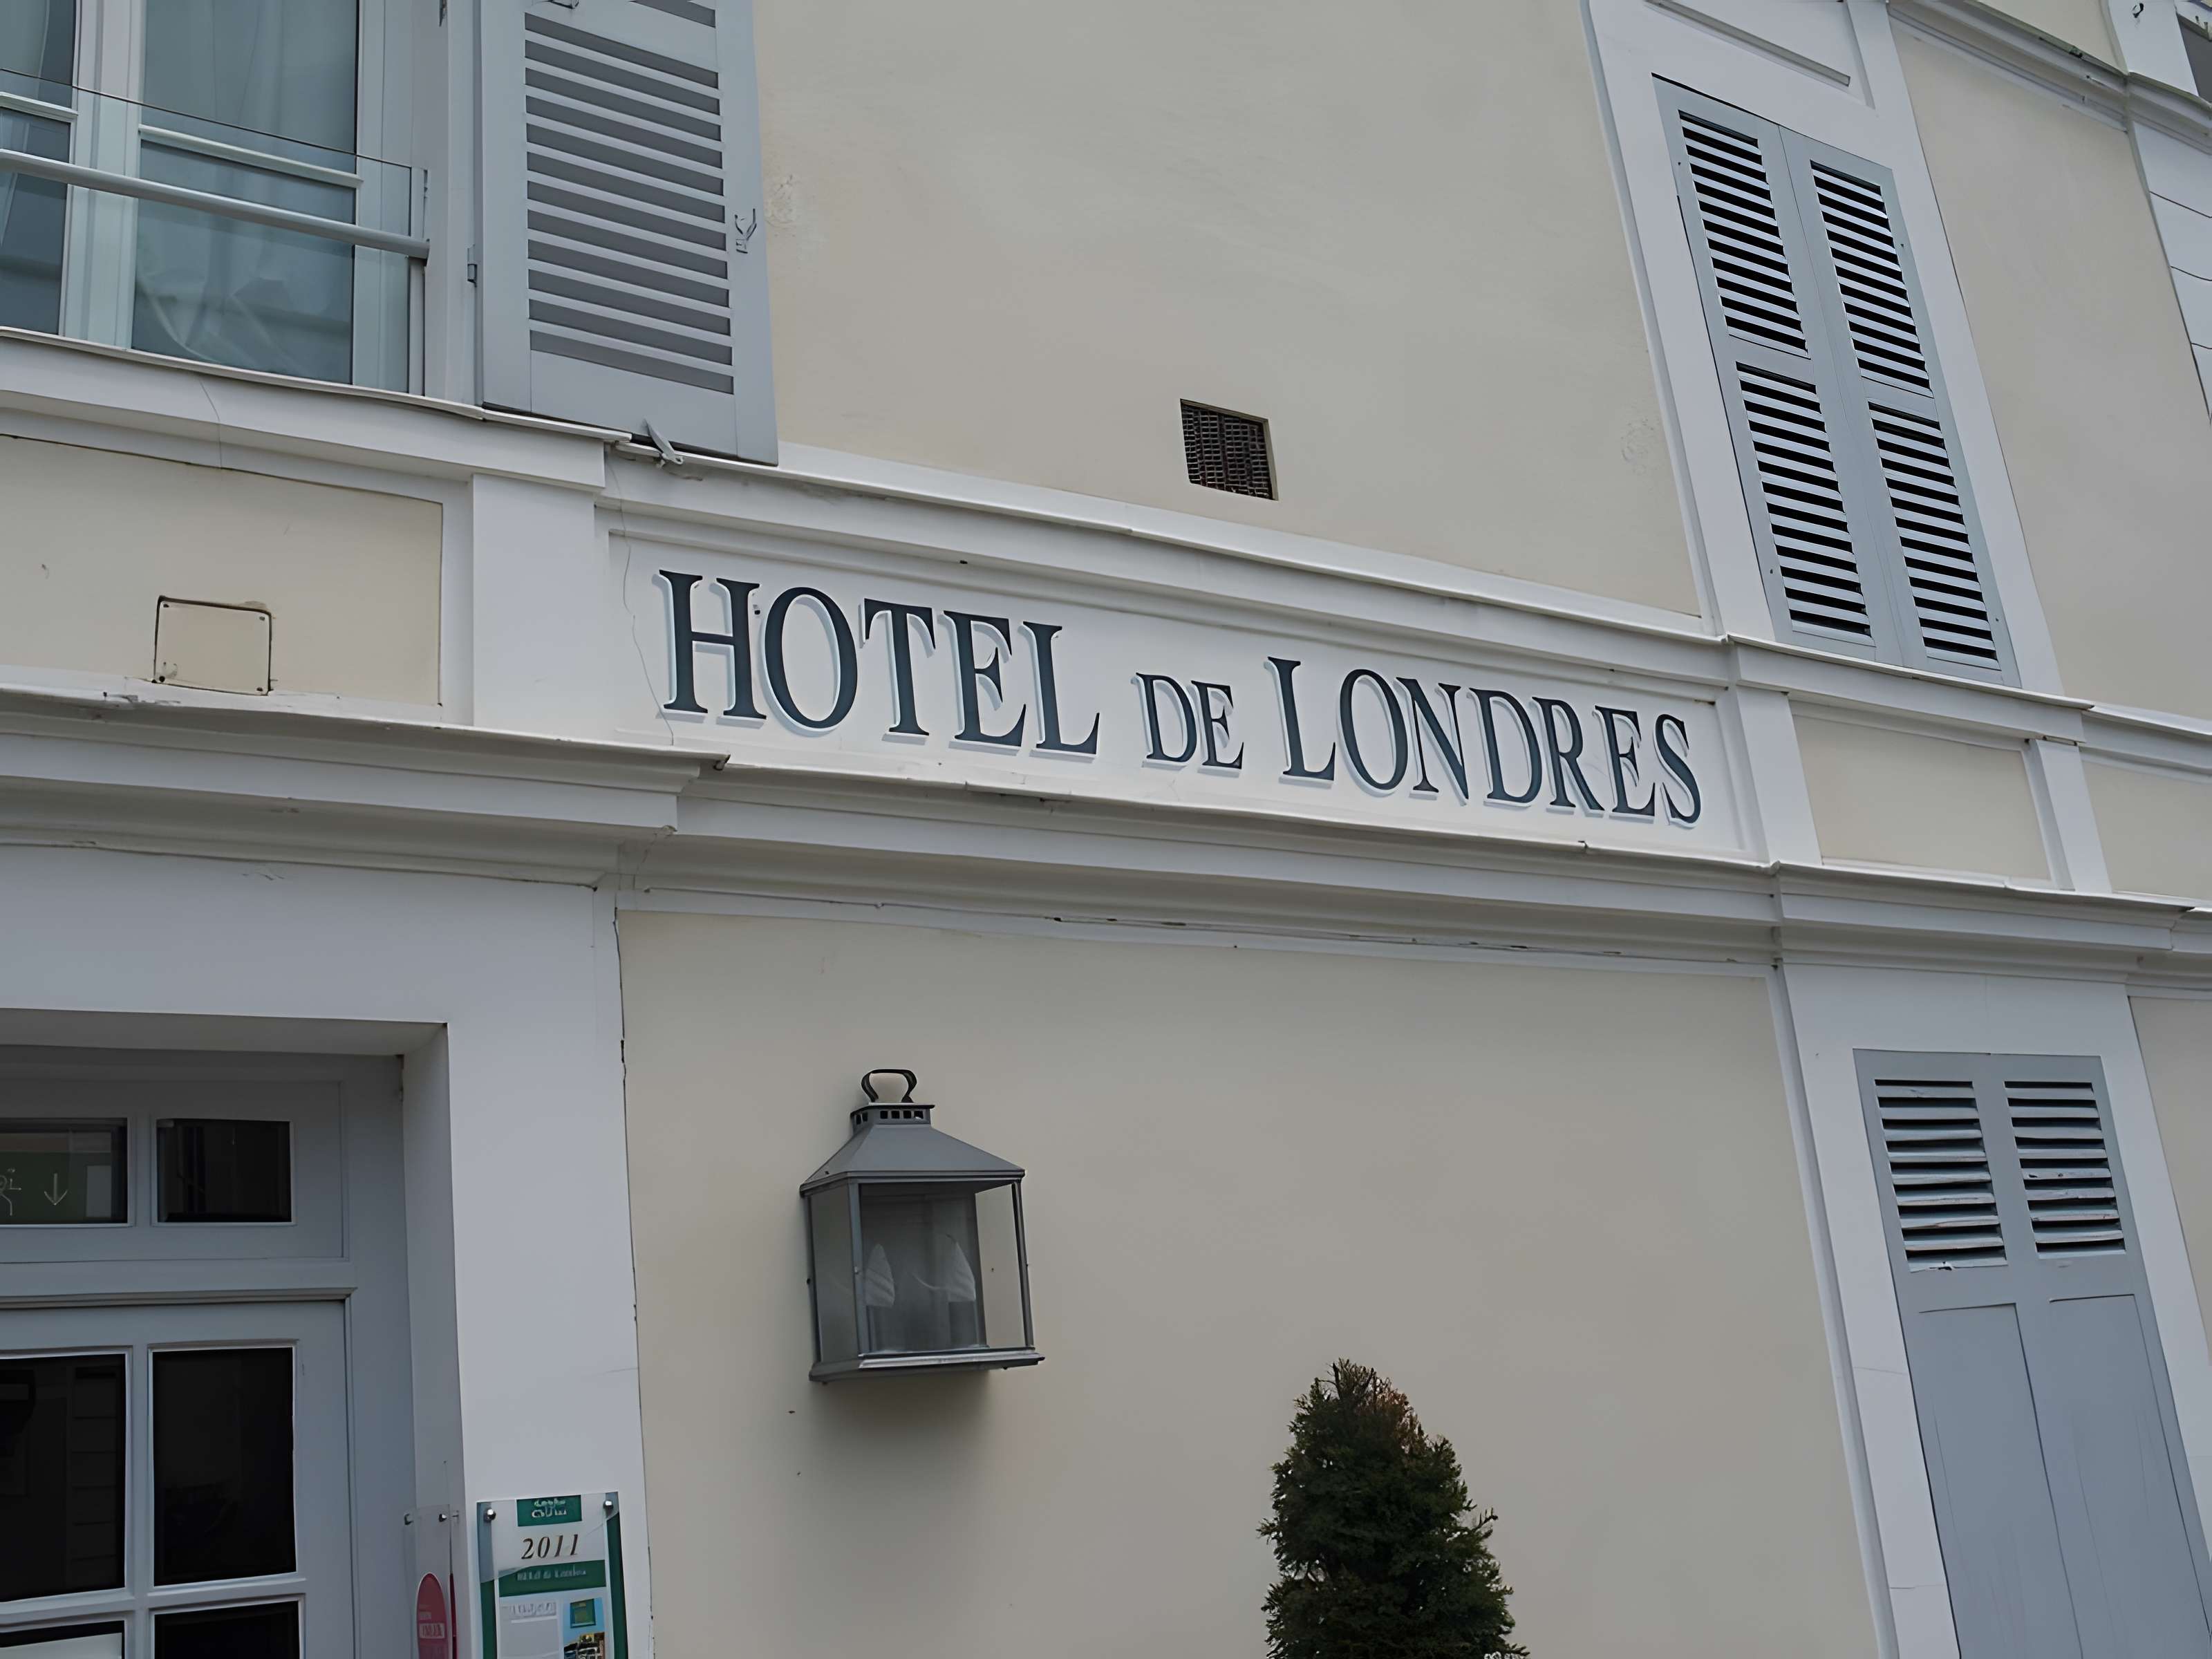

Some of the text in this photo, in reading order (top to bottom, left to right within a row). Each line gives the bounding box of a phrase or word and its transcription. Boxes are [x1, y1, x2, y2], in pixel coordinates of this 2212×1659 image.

[659, 569, 1701, 823] HOTEL DE LONDRES
[521, 1533, 579, 1560] 2011
